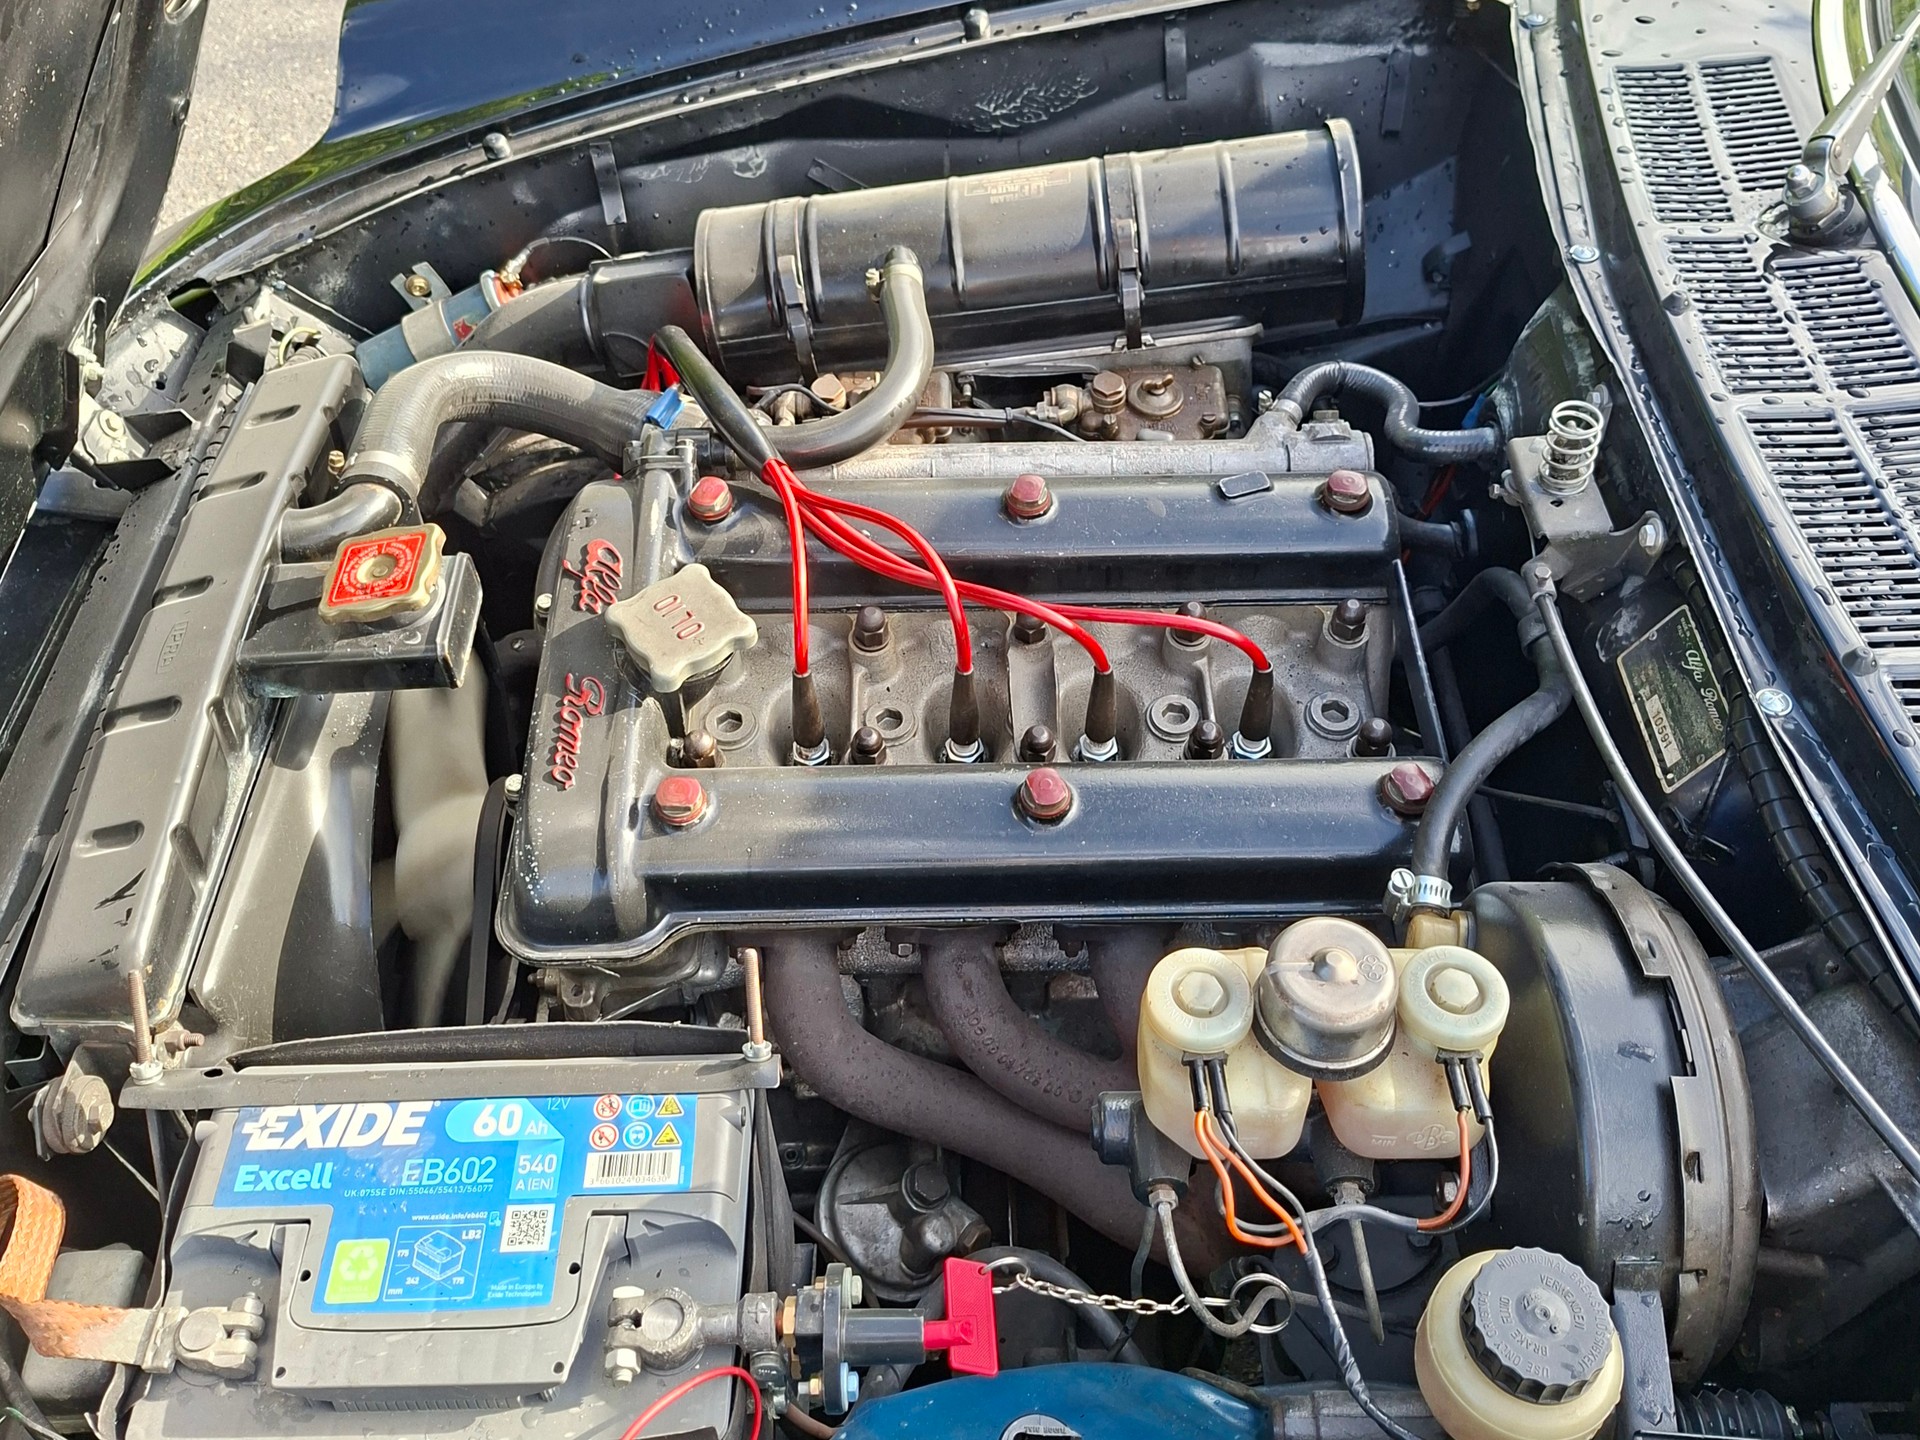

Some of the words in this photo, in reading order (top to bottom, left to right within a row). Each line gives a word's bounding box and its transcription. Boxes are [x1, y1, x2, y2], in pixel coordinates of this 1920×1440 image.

[562, 538, 623, 614] Alfa
[653, 594, 705, 640] OLIO
[1681, 649, 1706, 683] Alfa
[1700, 687, 1724, 732] Romeo
[552, 672, 605, 790] Romeo
[1651, 710, 1673, 749] 10591
[546, 1097, 571, 1110] 12V
[242, 1101, 434, 1151] EXIDE
[473, 1103, 523, 1137] 60
[525, 1120, 549, 1136] Ah
[233, 1161, 334, 1193] Excell
[401, 1156, 497, 1186] EB602
[517, 1154, 557, 1174] 540
[515, 1179, 525, 1191] A
[462, 1229, 482, 1240] LB2
[1497, 1253, 1518, 1271] NUR
[1519, 1253, 1568, 1274] ORIGINAL
[1493, 1341, 1522, 1366] ONLY
[1510, 1328, 1549, 1358] BRAKE
[1525, 1362, 1550, 1378] USE
